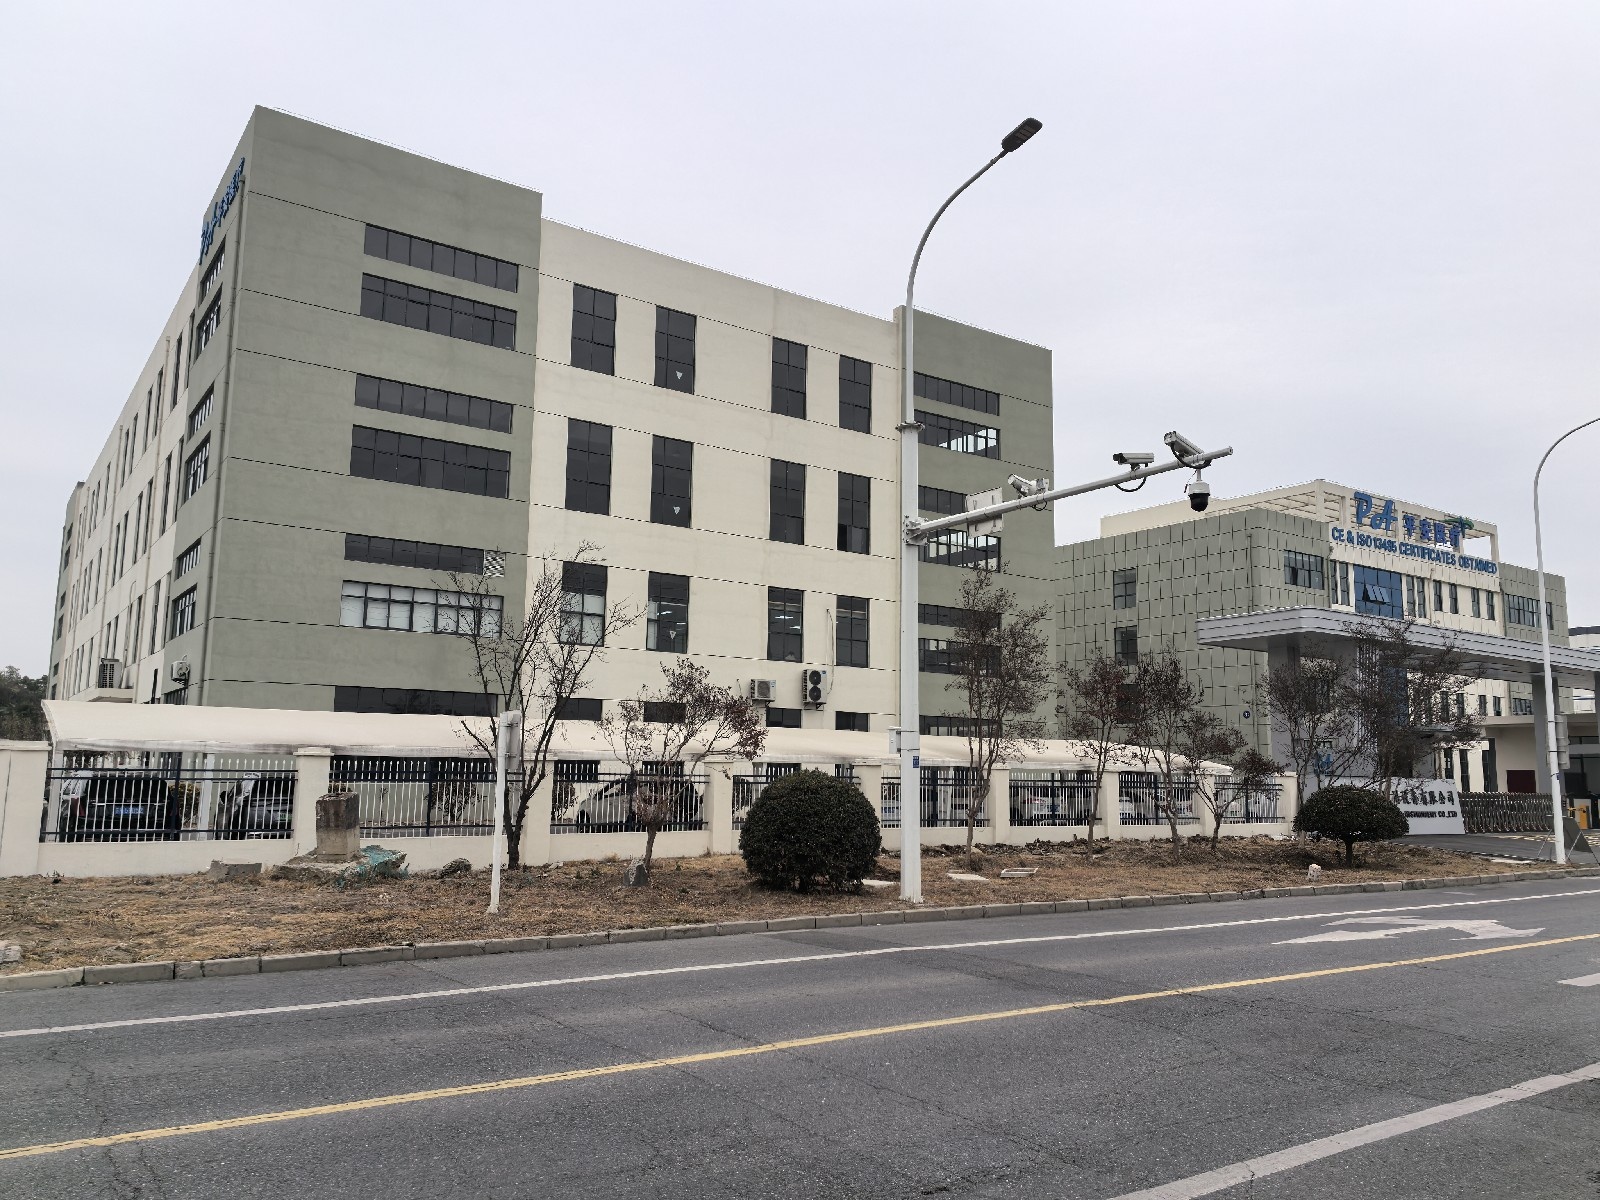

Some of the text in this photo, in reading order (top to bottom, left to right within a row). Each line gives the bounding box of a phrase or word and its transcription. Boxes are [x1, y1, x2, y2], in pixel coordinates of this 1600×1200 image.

[1331, 527, 1345, 542] CE
[1346, 530, 1354, 545] &
[1399, 542, 1456, 566] CERTIFICATES
[1458, 555, 1497, 574] OBTAINED
